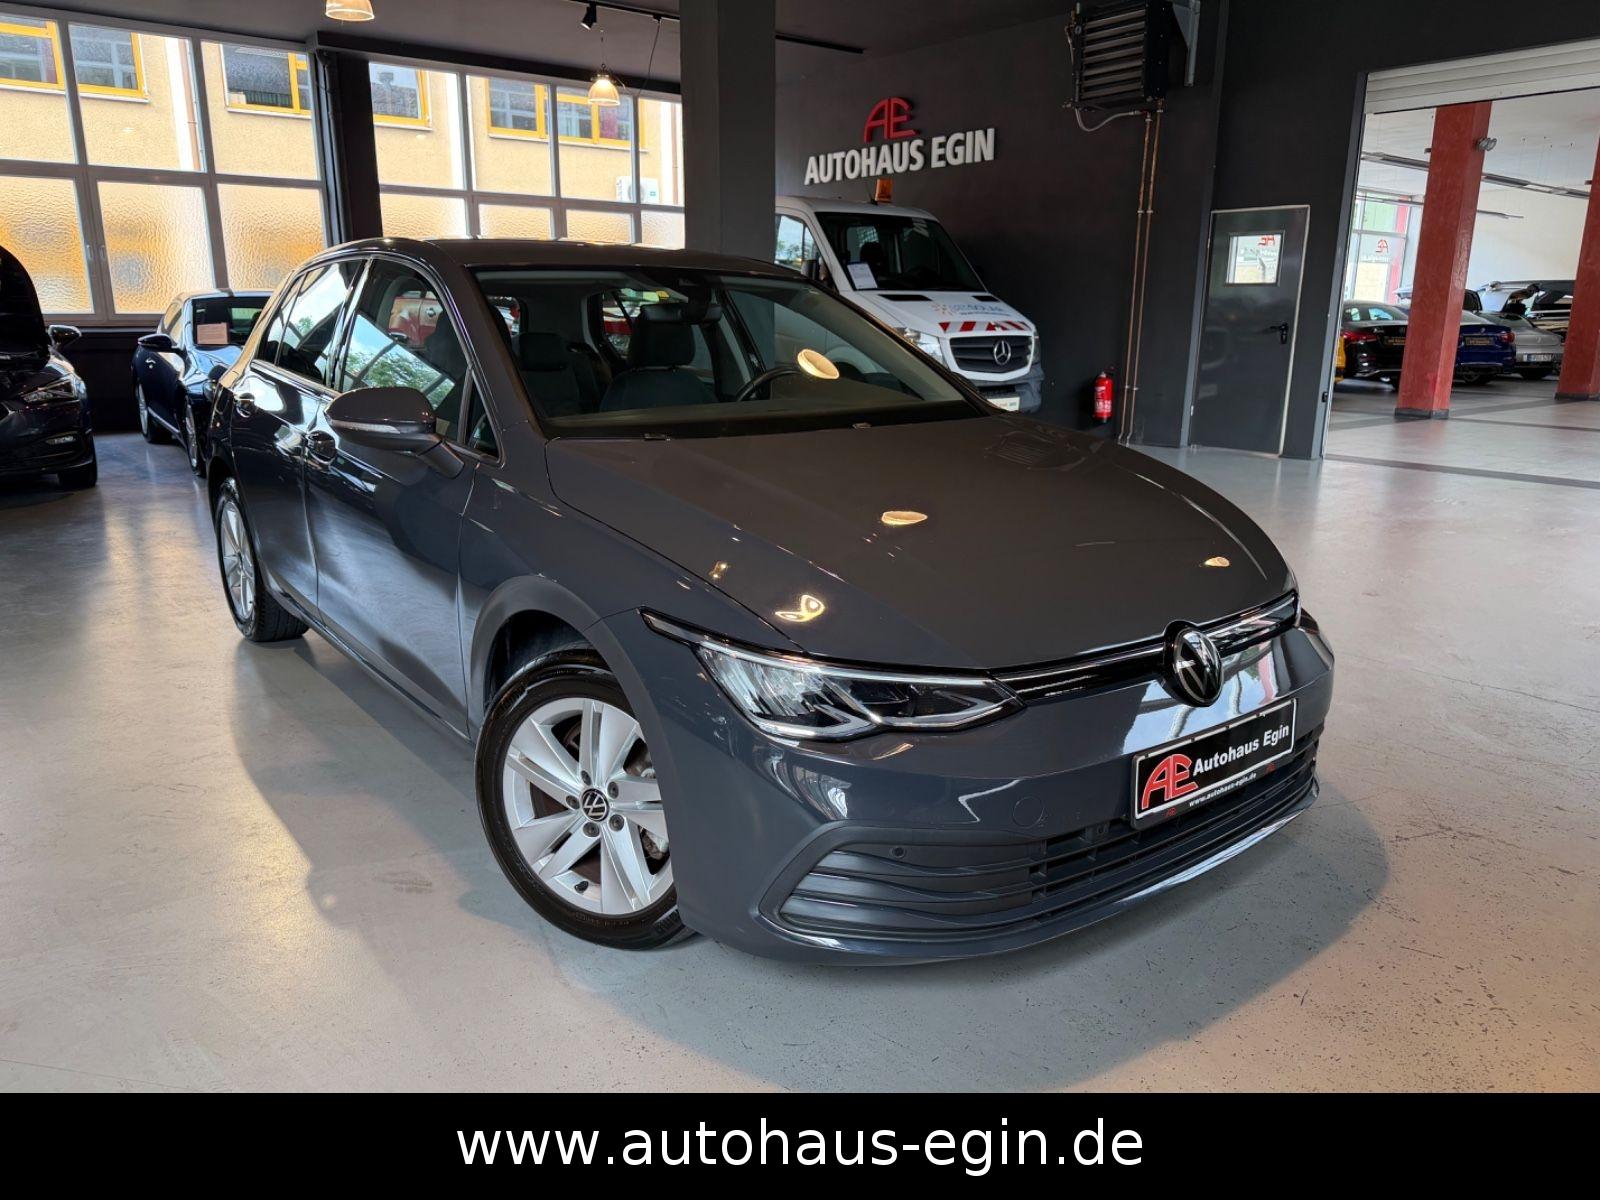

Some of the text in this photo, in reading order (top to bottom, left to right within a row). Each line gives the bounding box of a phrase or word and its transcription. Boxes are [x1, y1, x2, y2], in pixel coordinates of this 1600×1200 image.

[804, 128, 995, 185] AUTOHAUS EGIN
[1193, 724, 1289, 776] Autohaus Egin
[1189, 772, 1257, 807] www.autohaus-egin.de
